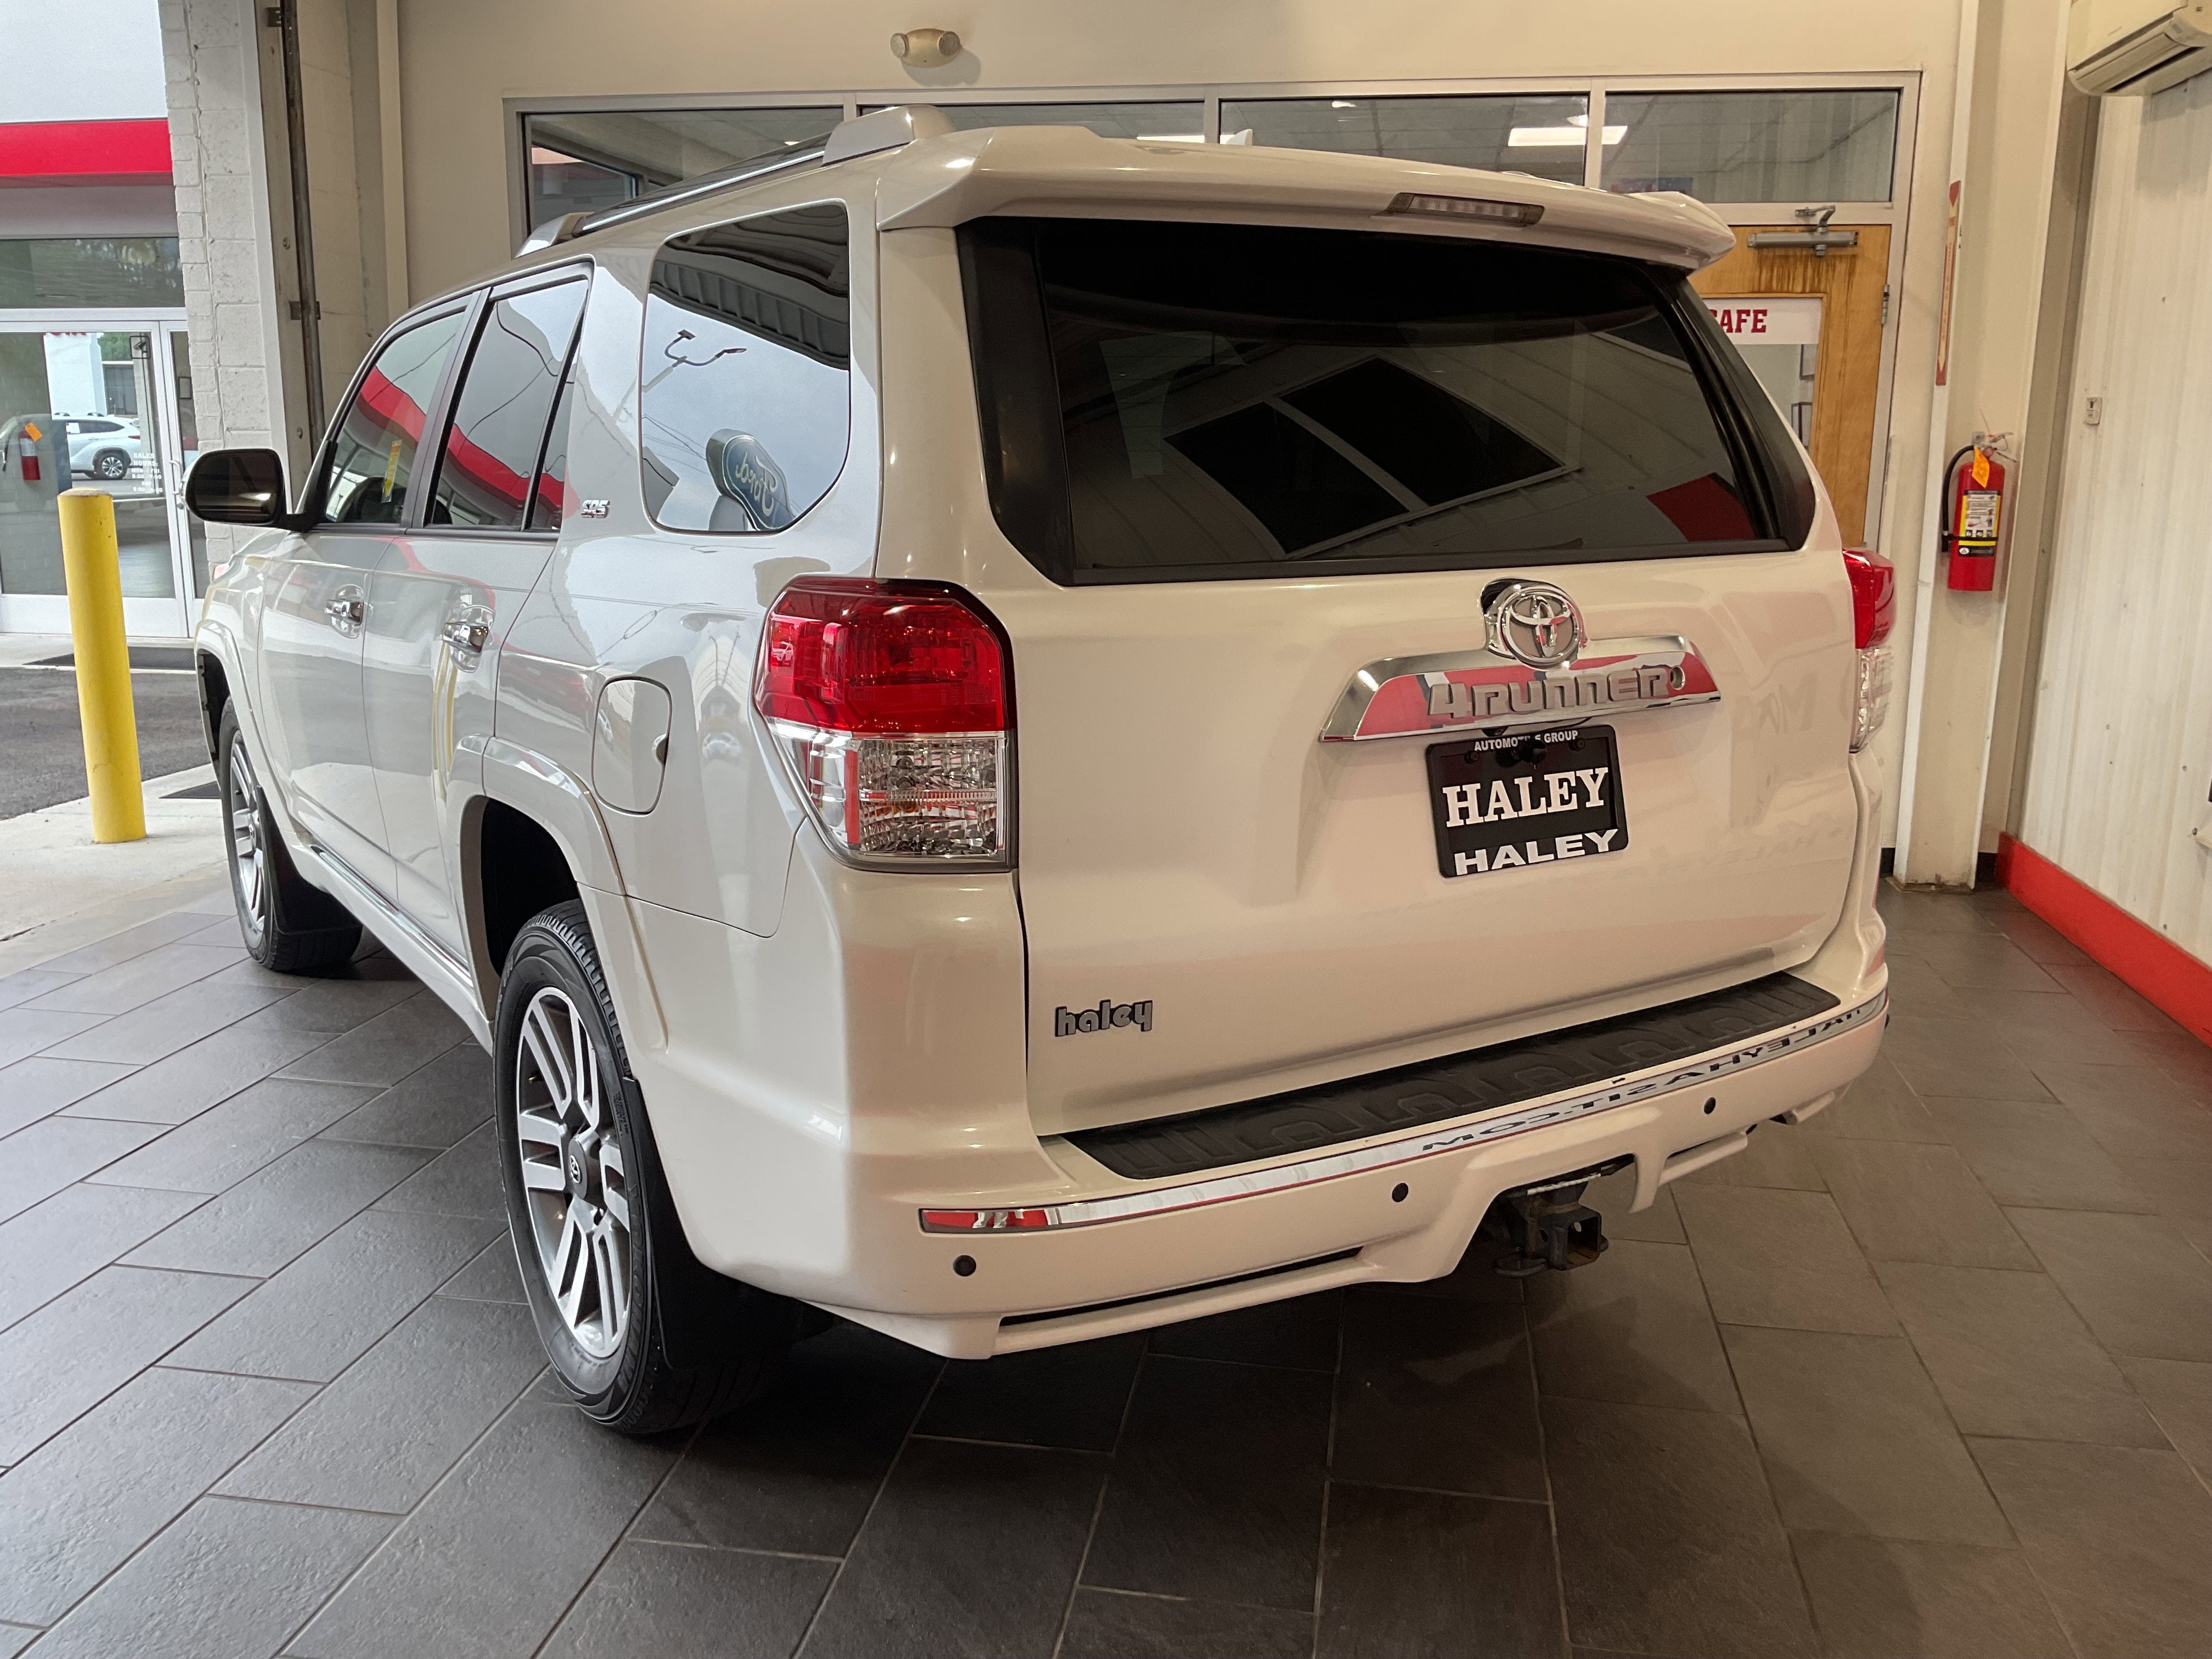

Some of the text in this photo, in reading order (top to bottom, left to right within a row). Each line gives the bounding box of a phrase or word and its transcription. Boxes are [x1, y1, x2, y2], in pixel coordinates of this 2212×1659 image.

[1708, 309, 1768, 334] AFE
[1474, 730, 1578, 751] AUTOMOE GROUP
[1442, 767, 1608, 827] HALEY
[1454, 828, 1618, 876] HALEY
[1055, 999, 1153, 1037] haley
